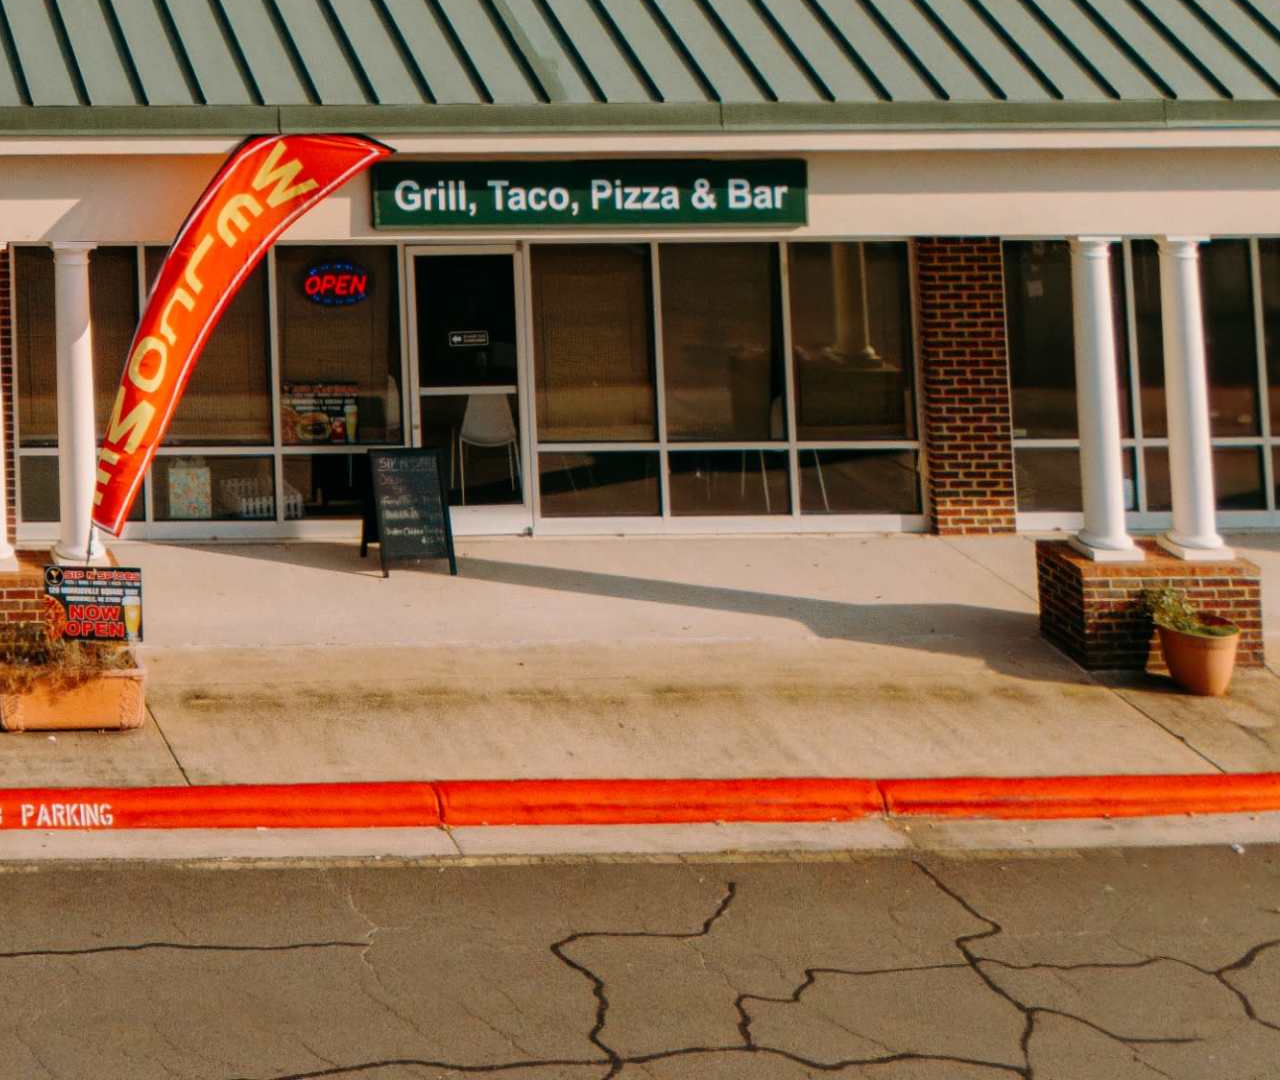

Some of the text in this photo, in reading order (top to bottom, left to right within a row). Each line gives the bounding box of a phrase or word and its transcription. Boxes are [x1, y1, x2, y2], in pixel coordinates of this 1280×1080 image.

[394, 178, 788, 217] Grill, Taco, Pizza & Bar
[304, 273, 367, 296] OPEN
[69, 604, 121, 620] NOW
[65, 620, 125, 638] OPEN
[20, 803, 114, 826] PARKING
